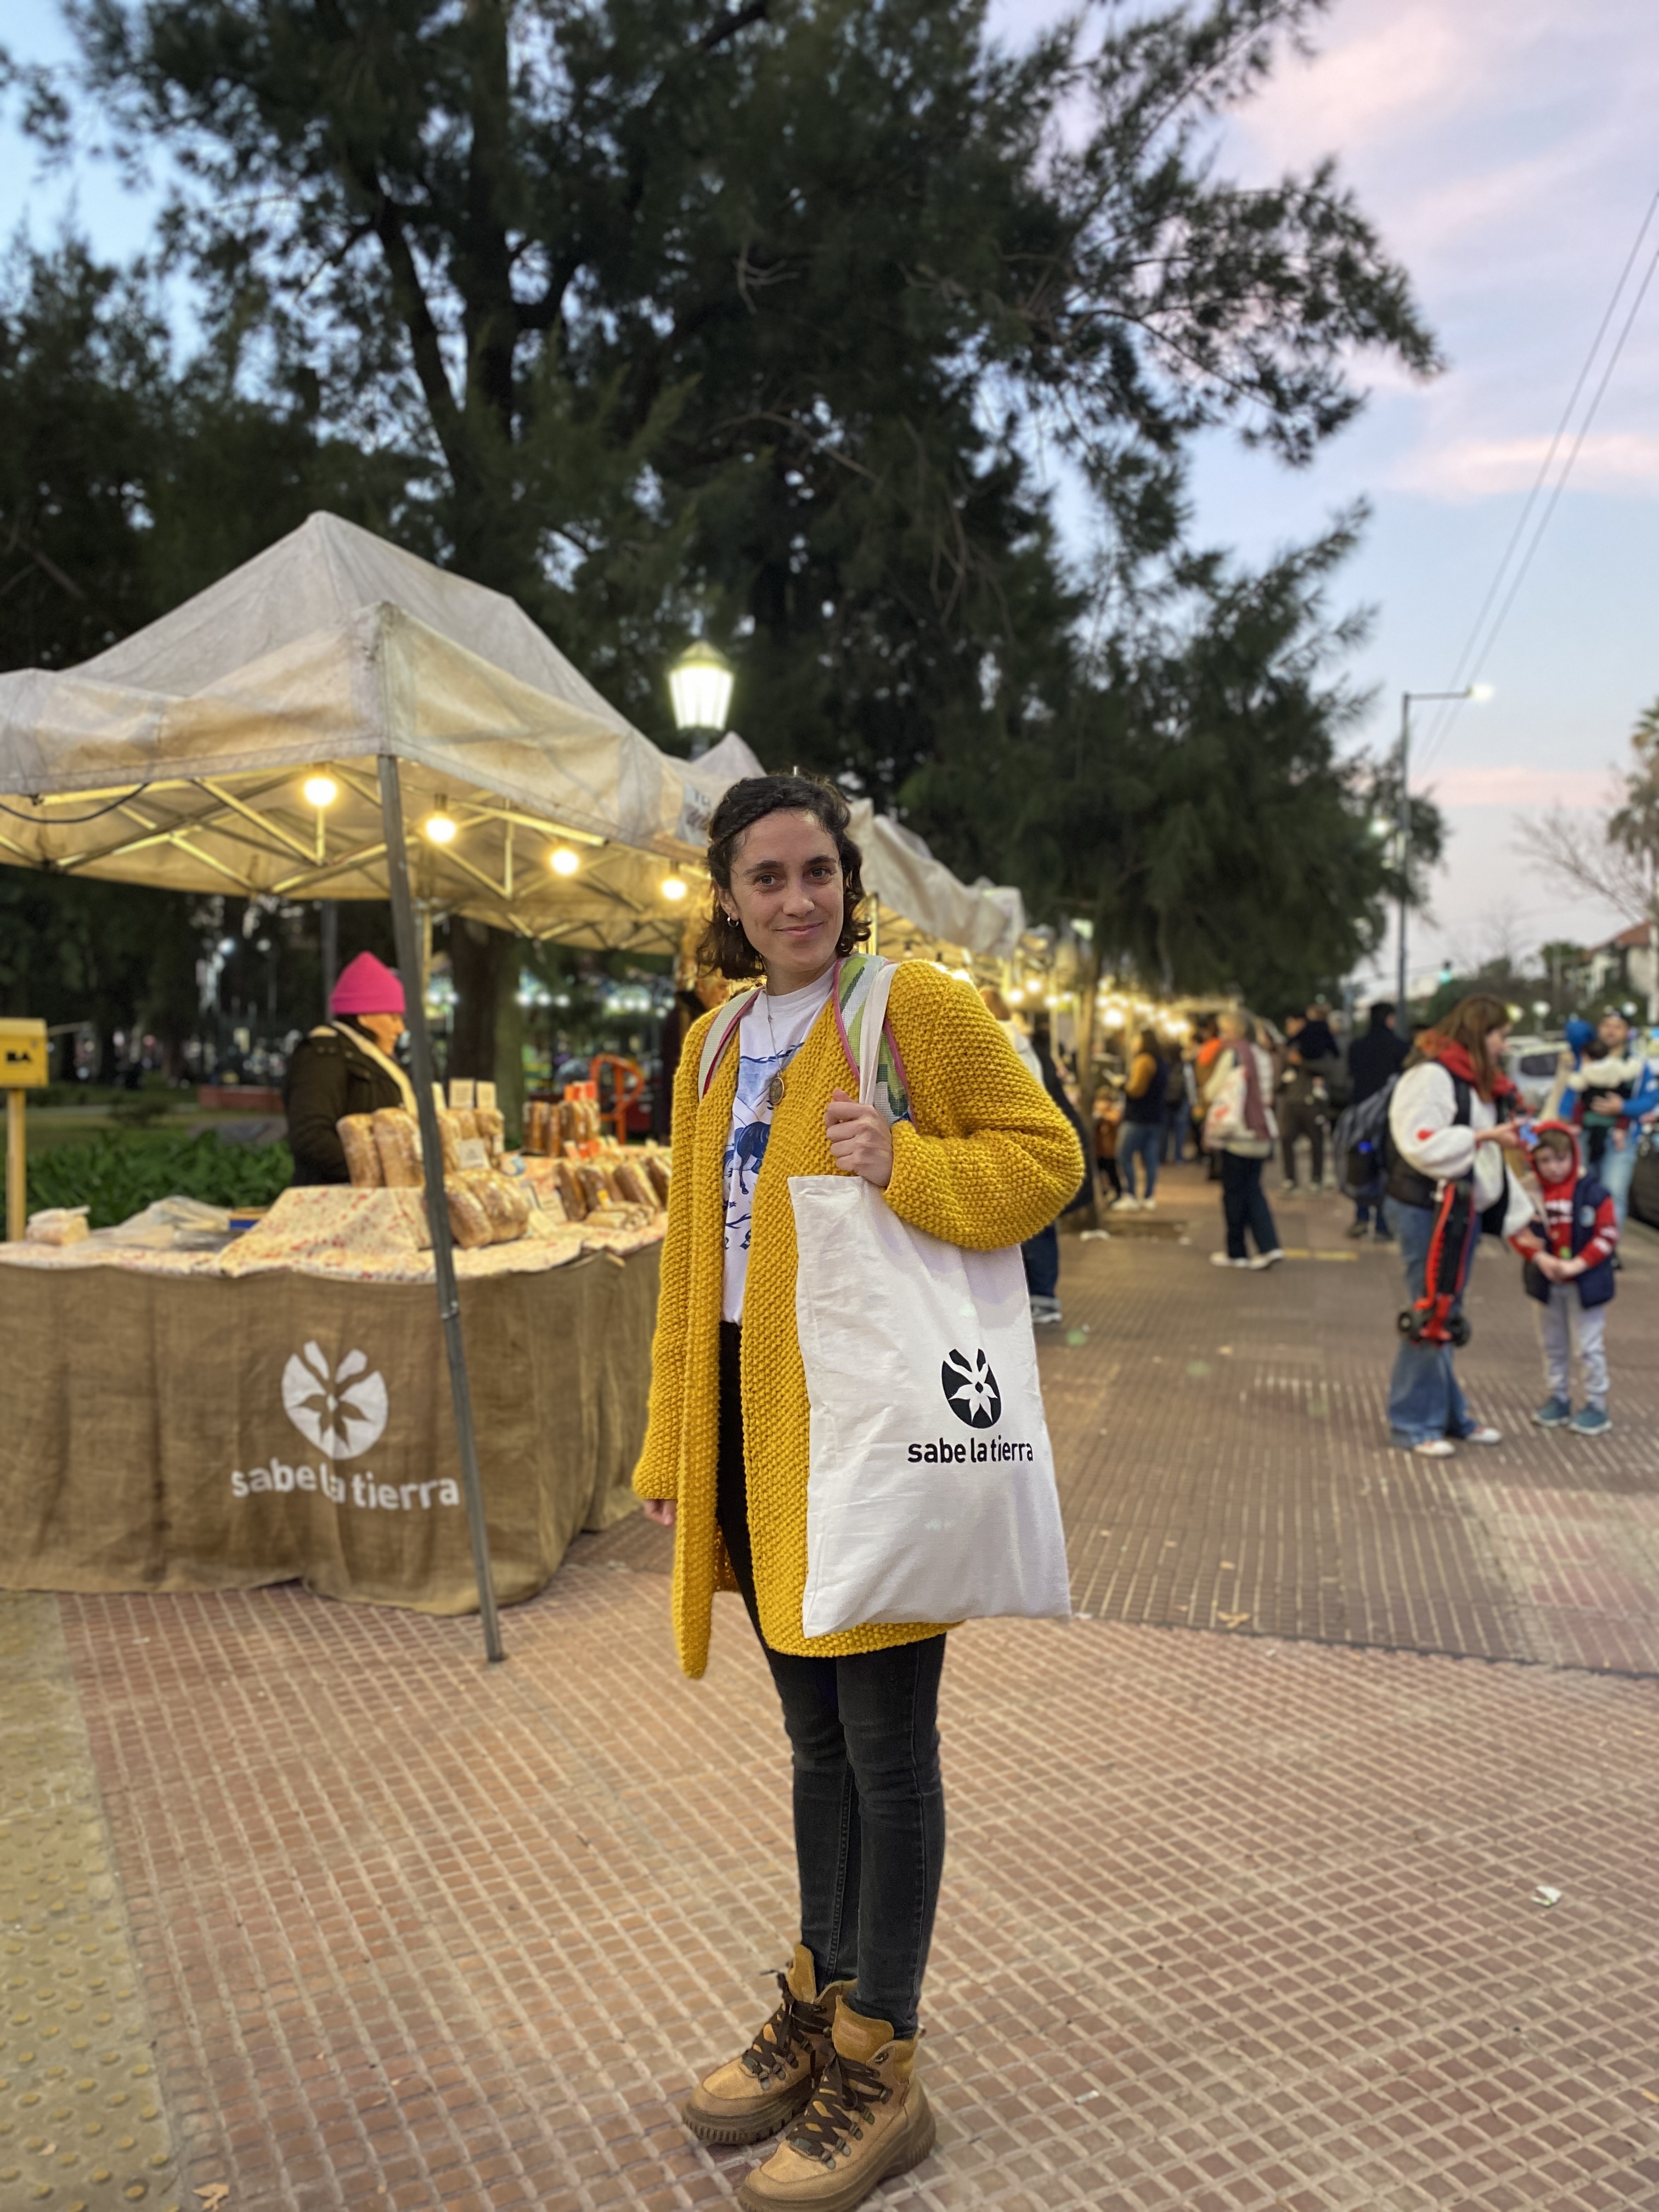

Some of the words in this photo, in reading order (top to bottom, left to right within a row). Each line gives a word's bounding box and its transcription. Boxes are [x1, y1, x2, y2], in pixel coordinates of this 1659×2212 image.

[907, 1437, 966, 1463] sabe
[970, 1437, 987, 1463] la
[990, 1435, 1033, 1462] tierra
[231, 1457, 317, 1498] sabe
[319, 1462, 346, 1503] la
[351, 1471, 460, 1510] tierra
